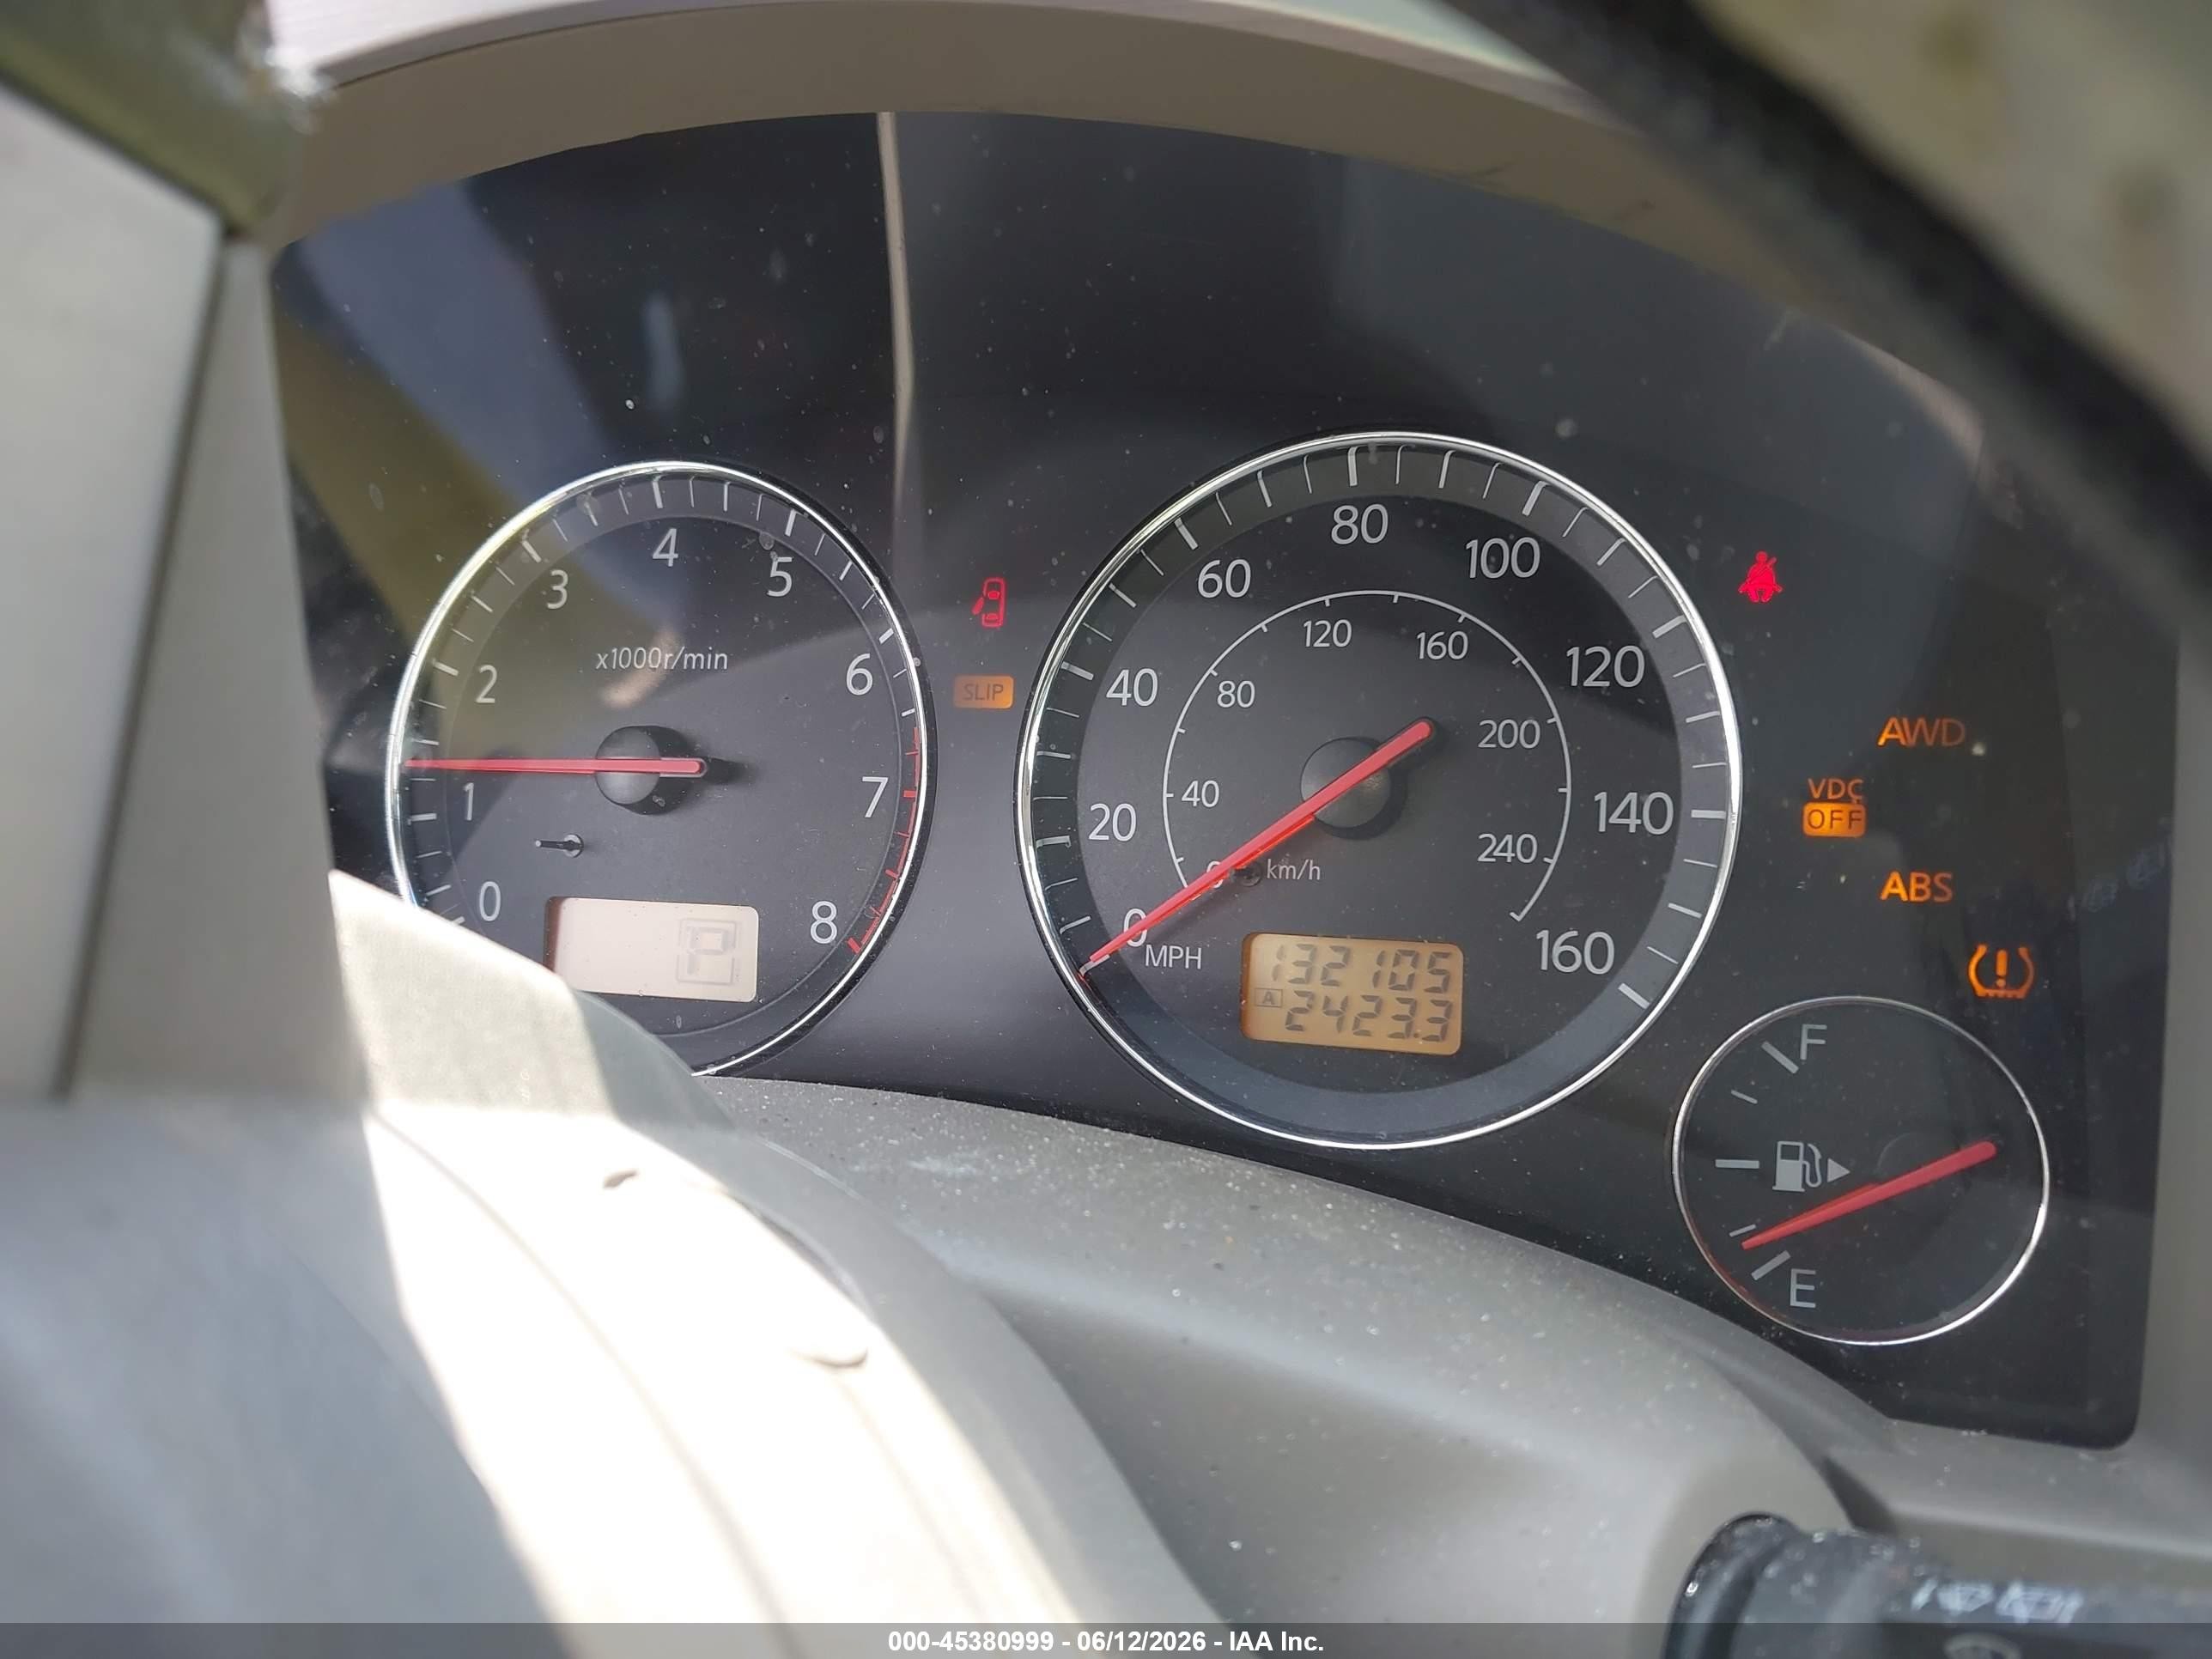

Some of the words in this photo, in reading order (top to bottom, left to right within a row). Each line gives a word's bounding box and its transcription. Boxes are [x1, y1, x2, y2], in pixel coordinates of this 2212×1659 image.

[1330, 505, 1389, 544] 80
[651, 527, 678, 567] 4
[1465, 538, 1541, 580] 100
[546, 569, 570, 610] 3
[768, 557, 793, 597] 5
[1197, 558, 1251, 599] 60
[1303, 617, 1352, 648] 120
[1416, 630, 1469, 661] 160
[595, 646, 729, 672] x1000r/min
[844, 653, 873, 696] 6
[1566, 645, 1645, 689] 120
[475, 665, 498, 704] 2
[963, 684, 1004, 702] SLIP
[1106, 666, 1158, 707] 40
[1217, 679, 1255, 708] 80
[1478, 719, 1540, 750] 200
[1877, 717, 1966, 747] AWD
[462, 783, 474, 822] 1
[862, 776, 889, 817] 7
[1181, 779, 1219, 809] 40
[1808, 778, 1863, 800] VDC
[1088, 802, 1137, 842] 20
[1592, 791, 1674, 836] 140
[1808, 809, 1862, 830] OFF
[1477, 832, 1538, 864] 240
[1267, 859, 1321, 881] km/h
[1880, 870, 1953, 902] ABS
[478, 881, 501, 921] 0
[811, 901, 839, 944] 8
[1123, 908, 1148, 947] 0
[1145, 945, 1202, 969] MPH
[1535, 928, 1615, 974] 160
[1285, 990, 1453, 1042] 2423.3
[1801, 1024, 1827, 1061] F
[1790, 1269, 1816, 1310] E
